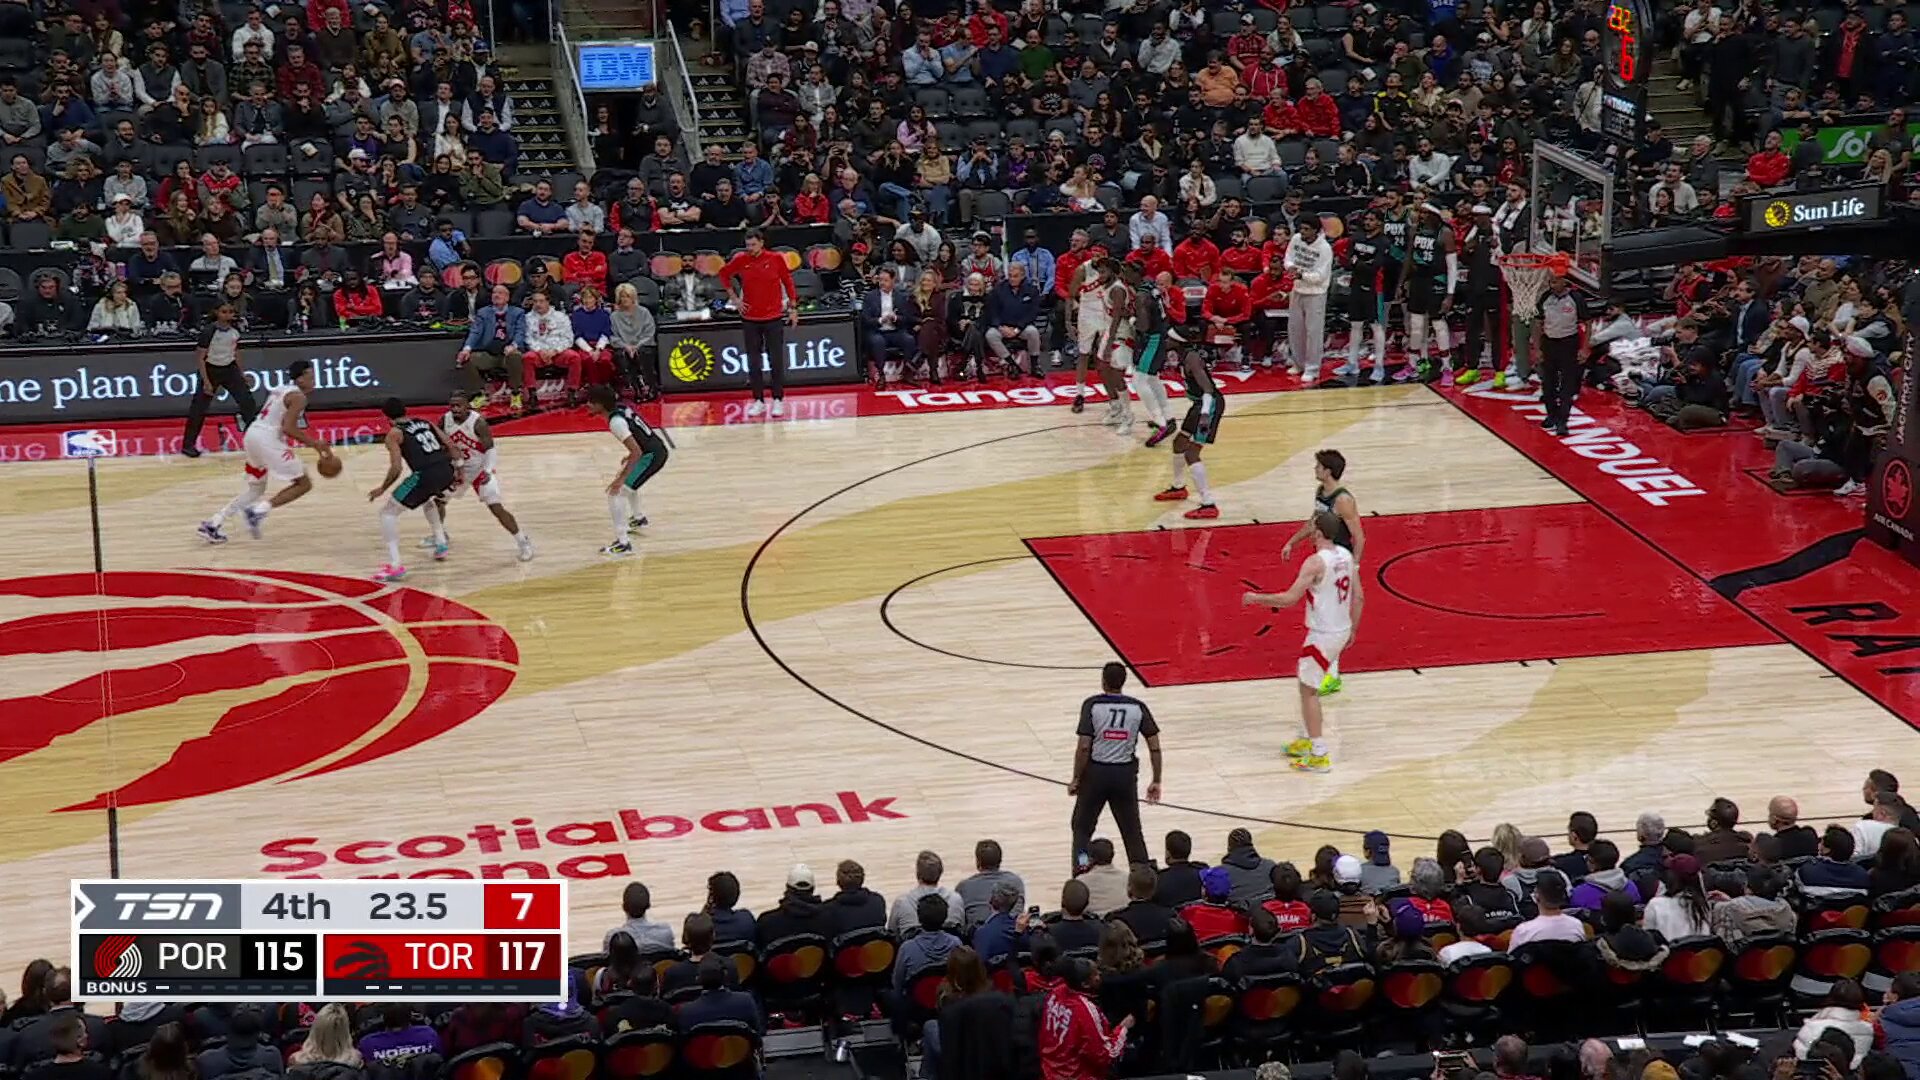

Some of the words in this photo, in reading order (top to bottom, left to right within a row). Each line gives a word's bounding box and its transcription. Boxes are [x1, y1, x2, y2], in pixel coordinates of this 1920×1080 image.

[1793, 204, 1828, 222] Sun
[1831, 197, 1865, 217] Life
[786, 338, 846, 370] Life
[51, 367, 140, 408] plan
[313, 357, 380, 389] life.
[415, 430, 441, 453] 33
[1334, 576, 1350, 605] 19
[1109, 708, 1127, 728] 77
[260, 792, 908, 874] Scotiabank
[373, 1044, 432, 1060] NORTH
